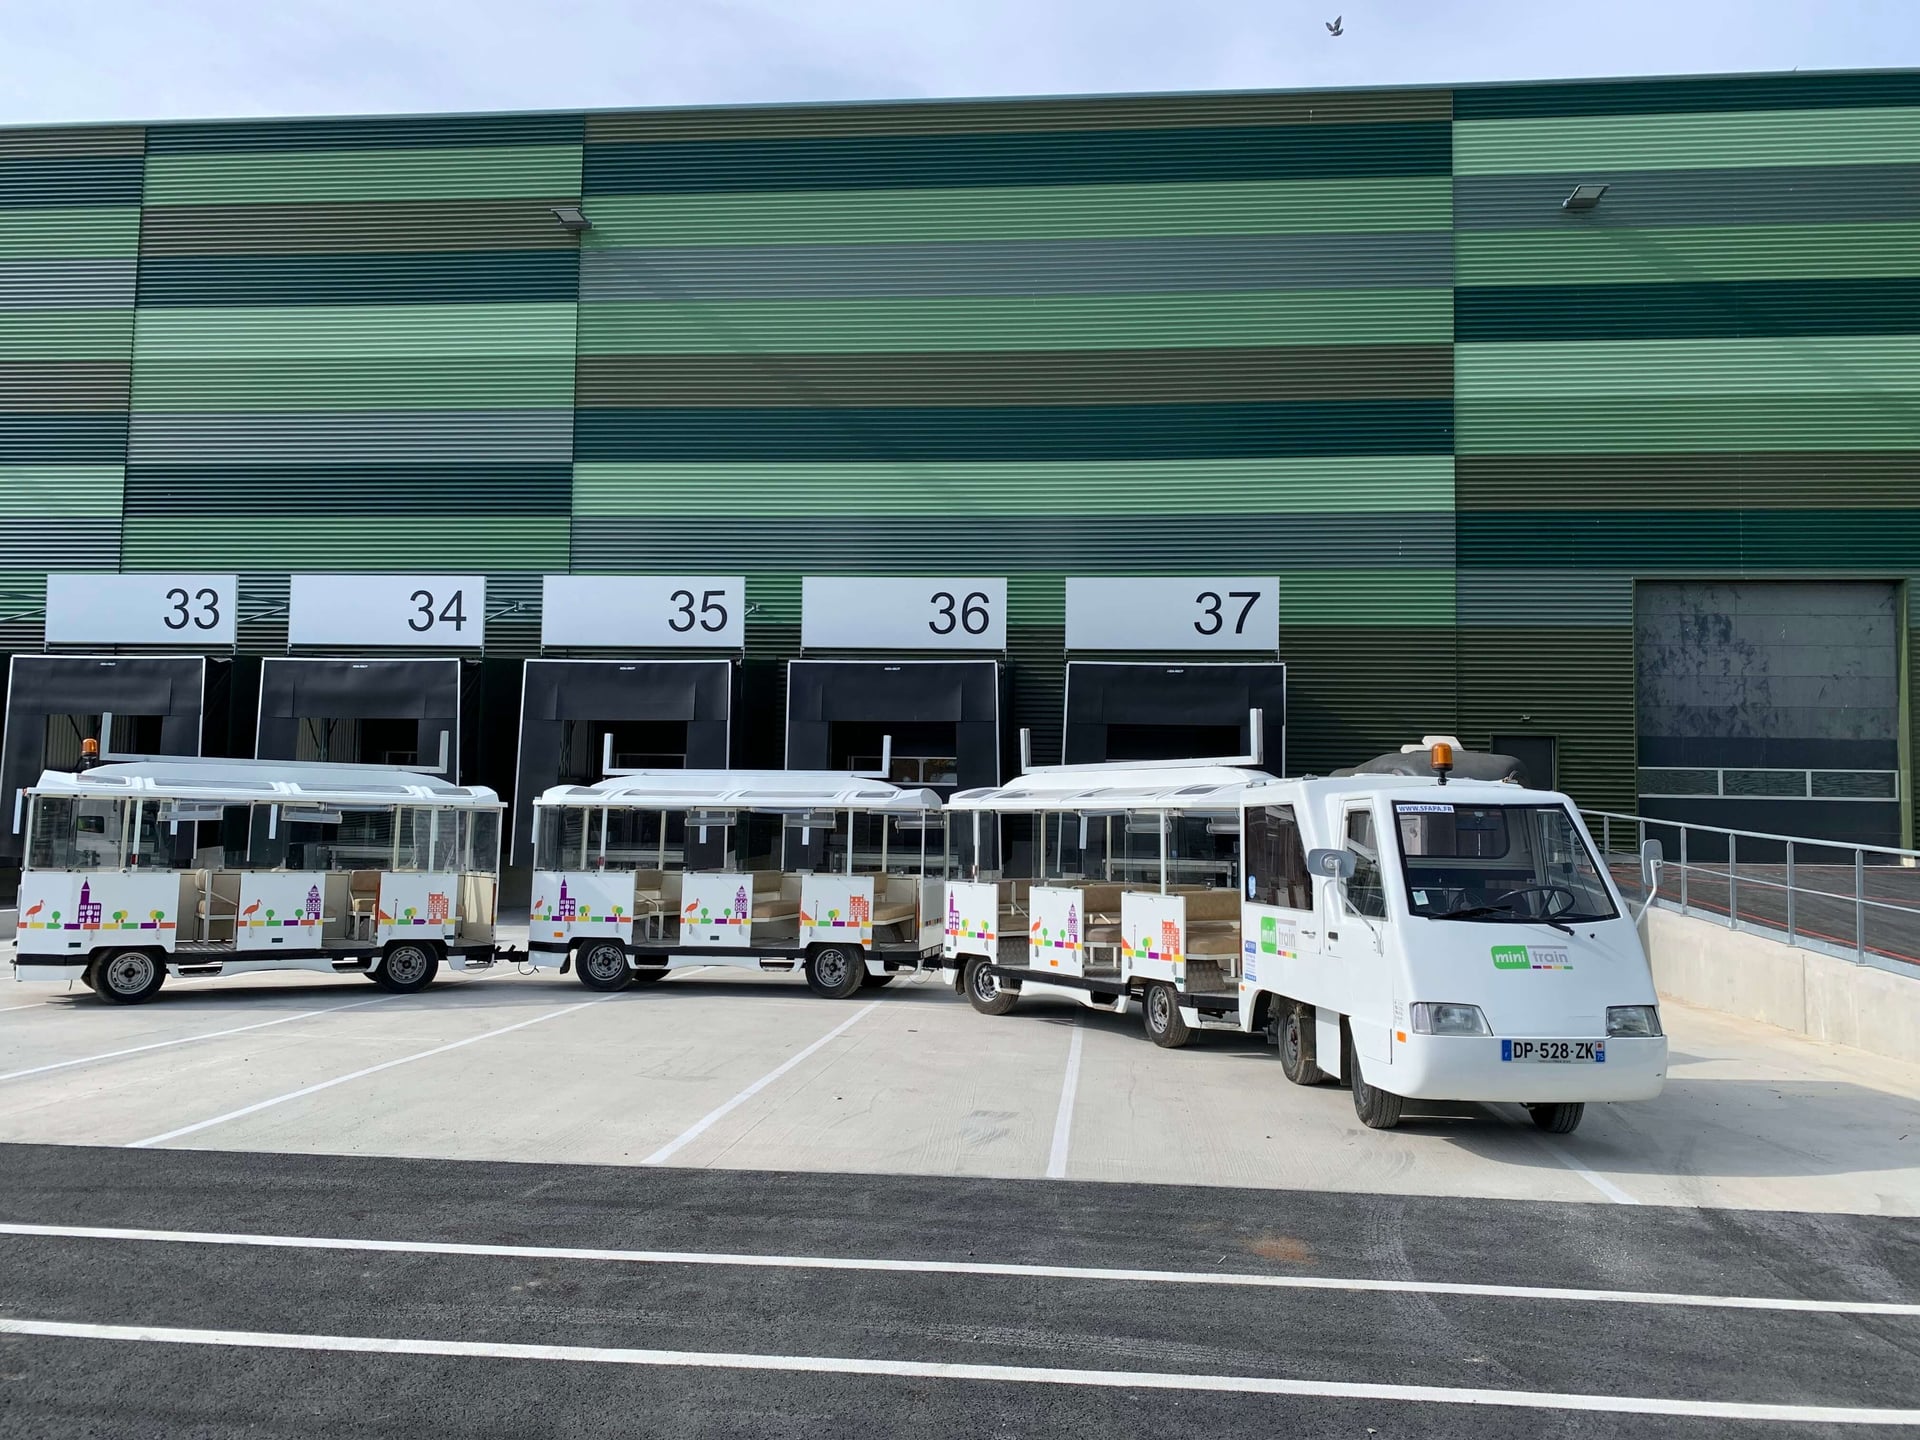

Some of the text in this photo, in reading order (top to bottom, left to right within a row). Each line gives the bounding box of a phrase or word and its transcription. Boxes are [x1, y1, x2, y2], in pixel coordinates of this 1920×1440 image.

[164, 588, 220, 630] 33
[408, 590, 467, 632] 34
[668, 590, 728, 633] 35
[929, 591, 990, 635] 36
[1194, 591, 1261, 636] 37
[1261, 926, 1276, 945] mini
[1278, 928, 1296, 948] train
[1495, 951, 1569, 963] mini train
[1513, 1041, 1594, 1059] DP-528-ZK
